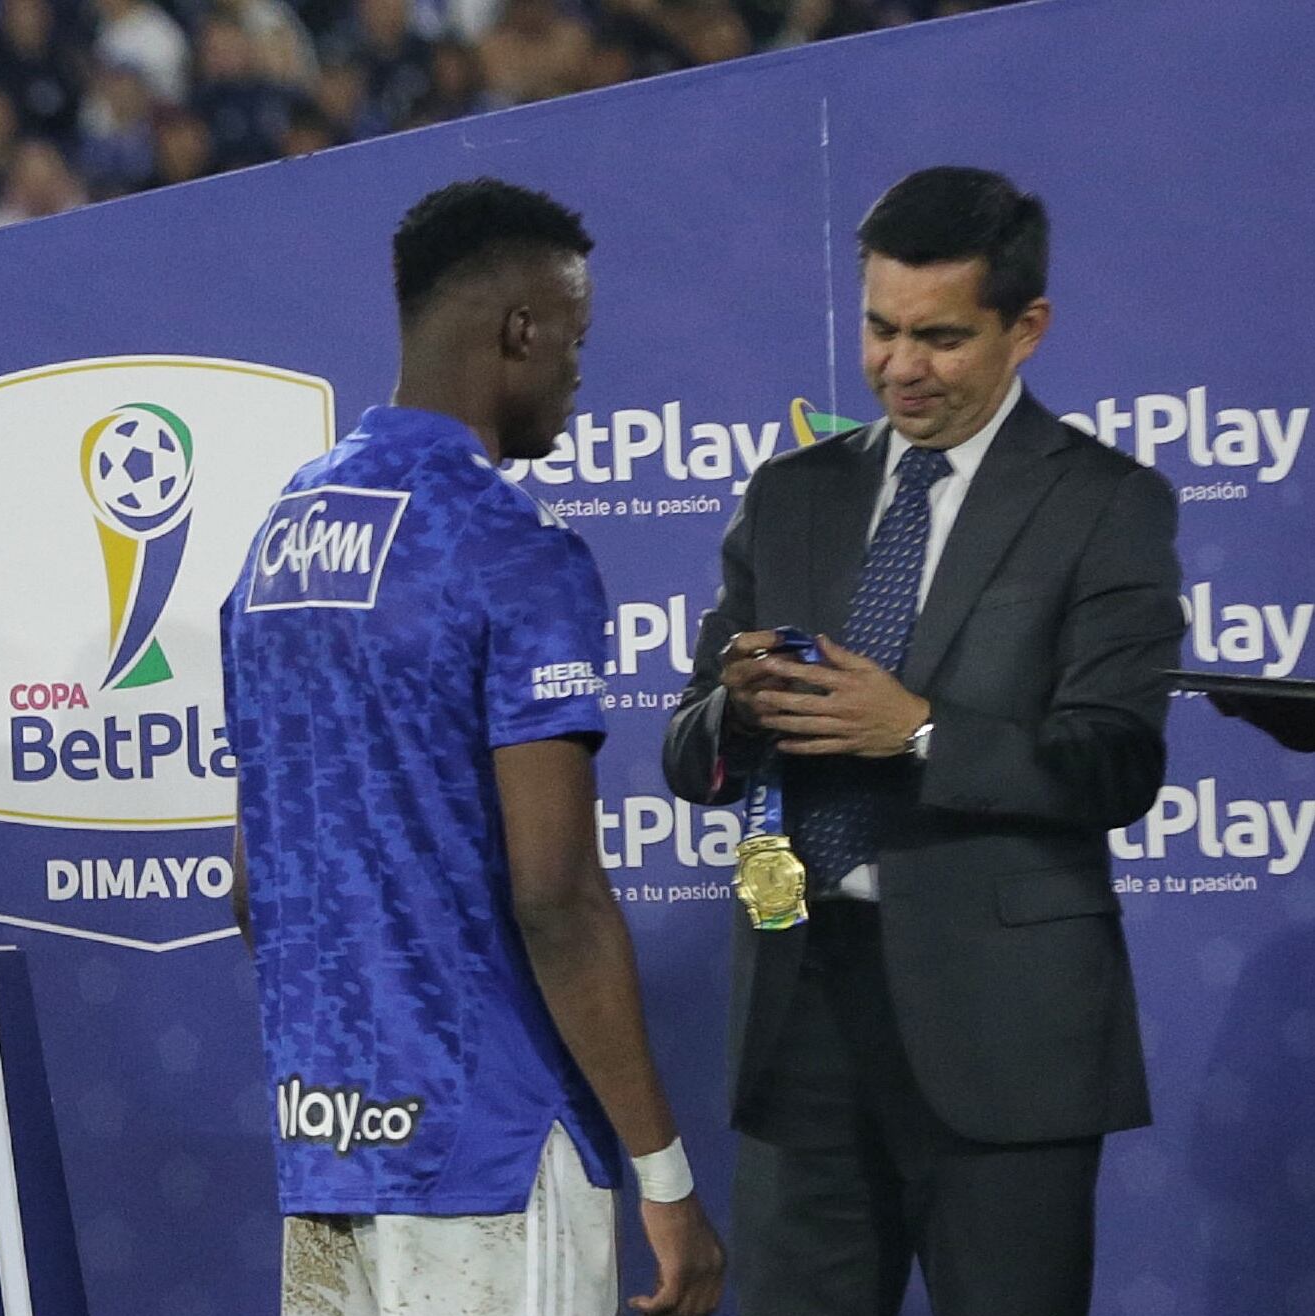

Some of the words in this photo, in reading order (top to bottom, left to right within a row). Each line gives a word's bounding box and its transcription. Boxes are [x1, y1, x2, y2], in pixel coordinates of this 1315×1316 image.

[1059, 386, 1310, 483] tPlay
[615, 501, 627, 514] a
[633, 498, 652, 514] tu
[659, 495, 720, 516] pasión
[1180, 482, 1248, 503] pasión
[10, 683, 88, 710] COPA
[11, 706, 237, 782] BetPla
[595, 796, 746, 870] tPla
[46, 856, 233, 901] DIMAYO
[626, 887, 637, 900] a
[643, 884, 663, 900] tu
[669, 882, 730, 902] pasión
[1147, 879, 1160, 892] a
[1166, 875, 1186, 892] tu
[1191, 872, 1257, 894] pasión
[278, 1079, 412, 1151] lay.co
